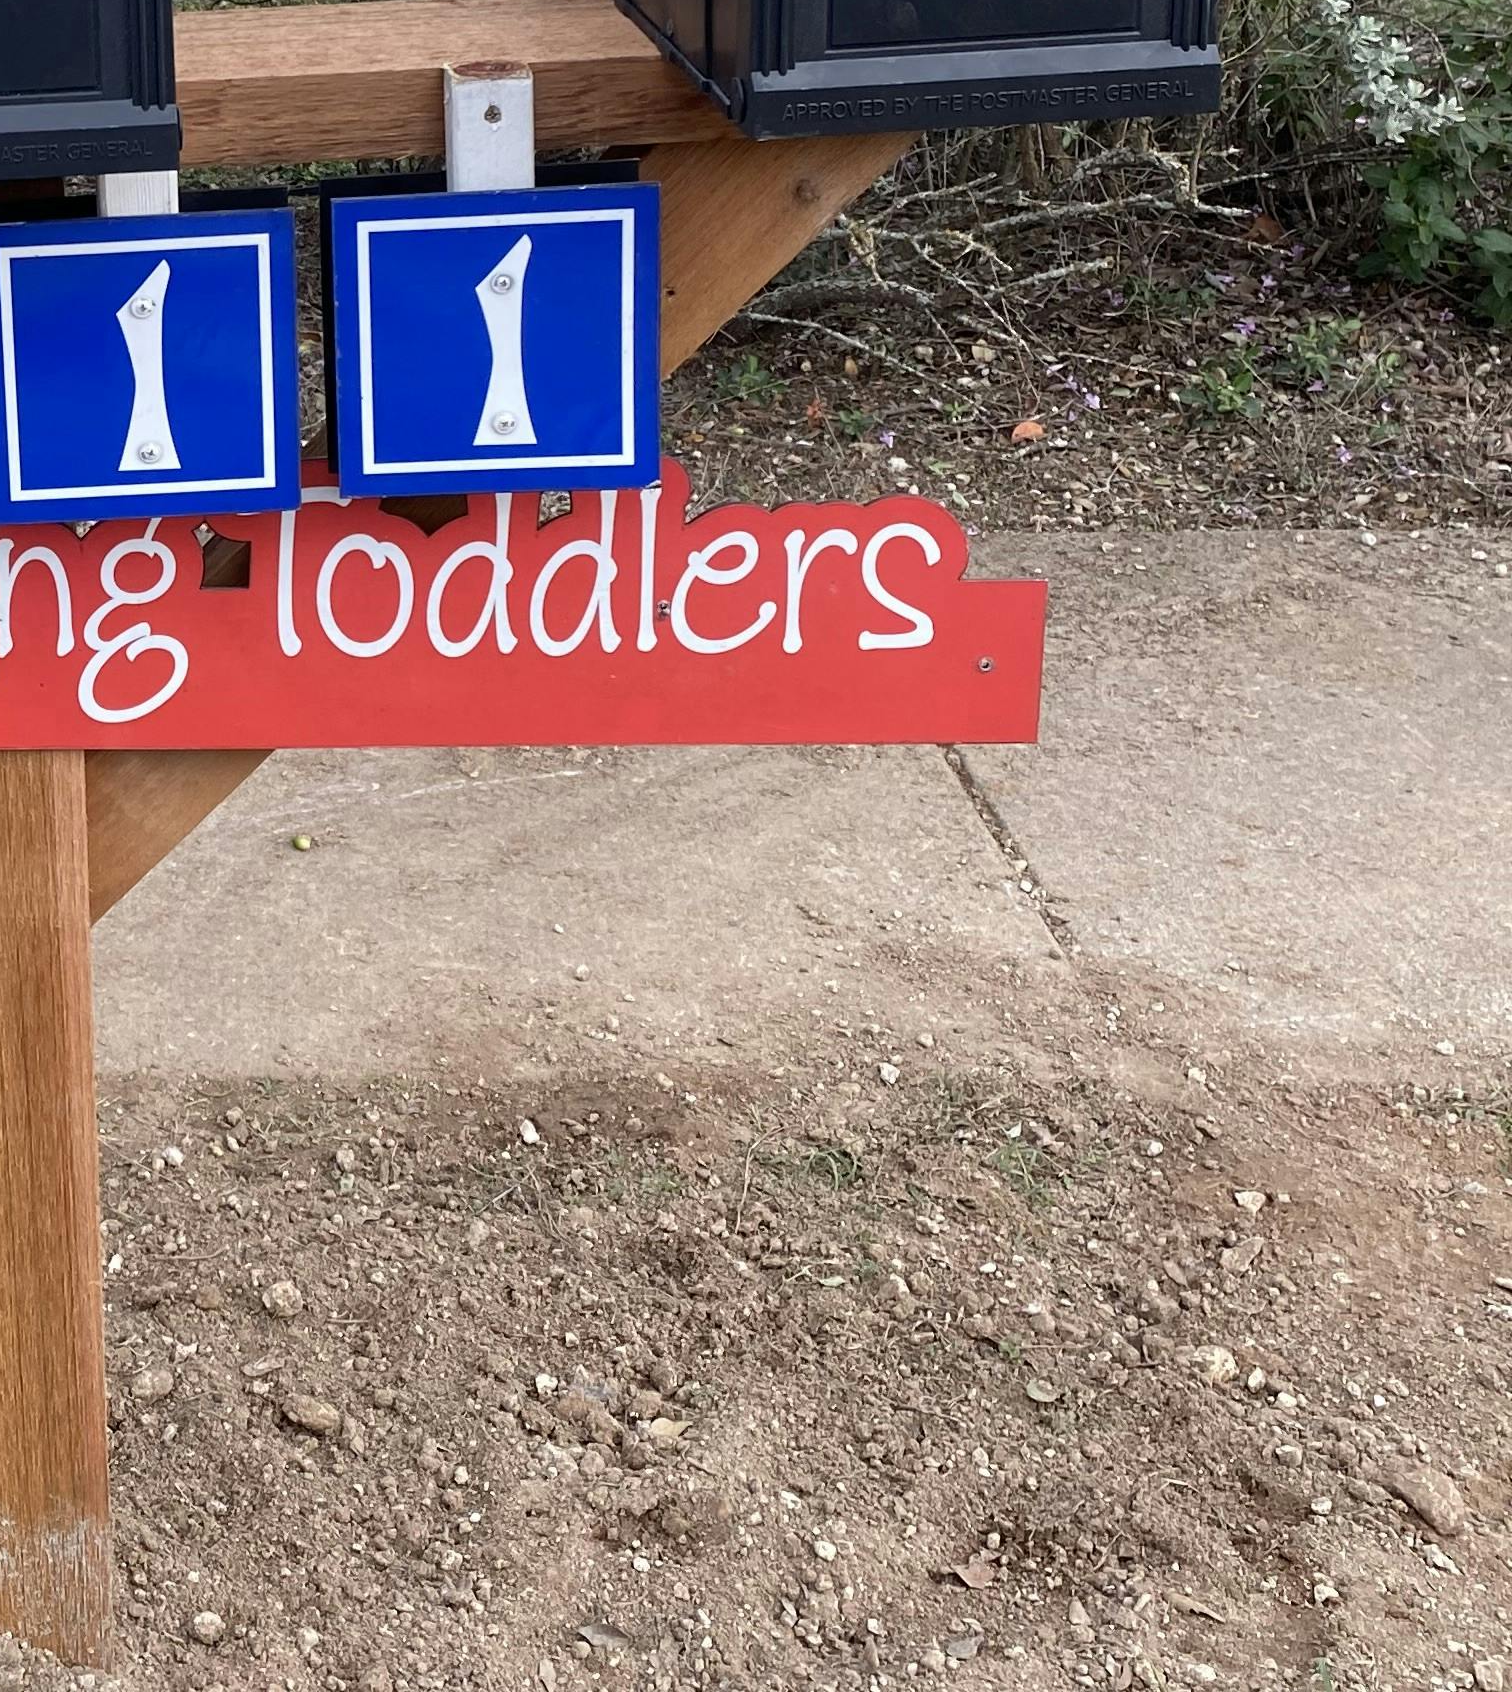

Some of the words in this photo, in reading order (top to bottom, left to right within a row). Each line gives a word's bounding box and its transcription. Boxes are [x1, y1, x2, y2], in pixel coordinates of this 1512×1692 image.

[65, 139, 152, 162] GENERAL
[782, 99, 886, 122] APPROVED
[893, 96, 919, 116] BY
[921, 94, 963, 113] THE
[969, 84, 1098, 110] POSTMASTER
[1105, 79, 1195, 103] GENERAL
[116, 260, 182, 471] 1
[473, 234, 538, 446] 1
[276, 485, 942, 658] Toddlers
